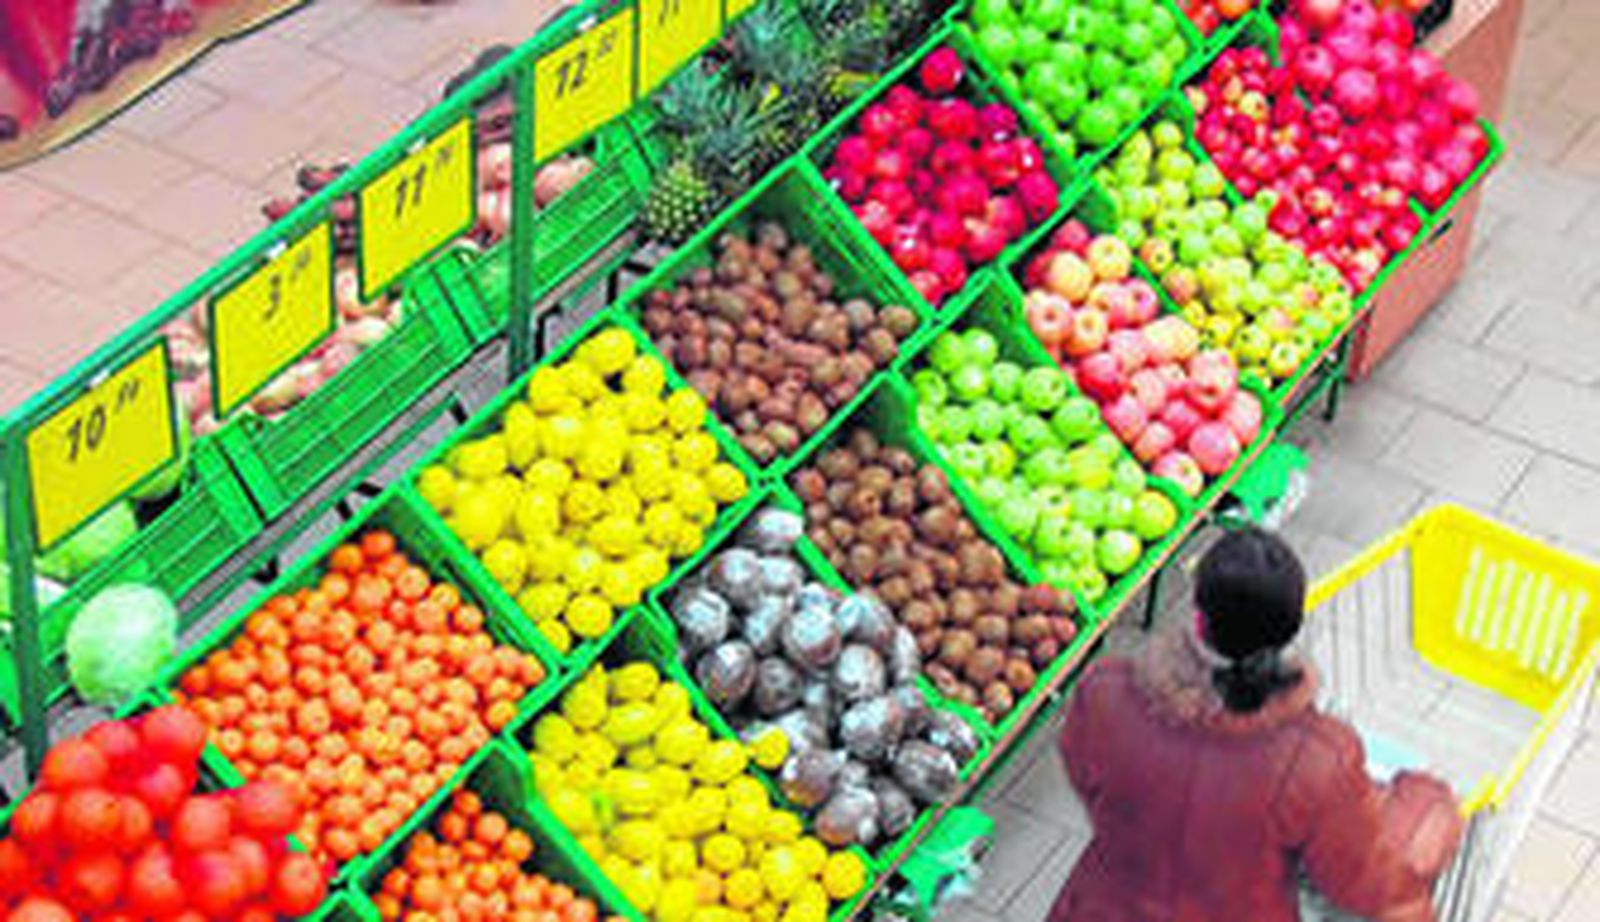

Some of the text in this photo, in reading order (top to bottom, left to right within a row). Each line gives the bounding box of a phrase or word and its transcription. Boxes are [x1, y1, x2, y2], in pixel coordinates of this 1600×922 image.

[554, 50, 587, 98] 12
[396, 163, 426, 217] 11
[67, 405, 107, 463] 10
